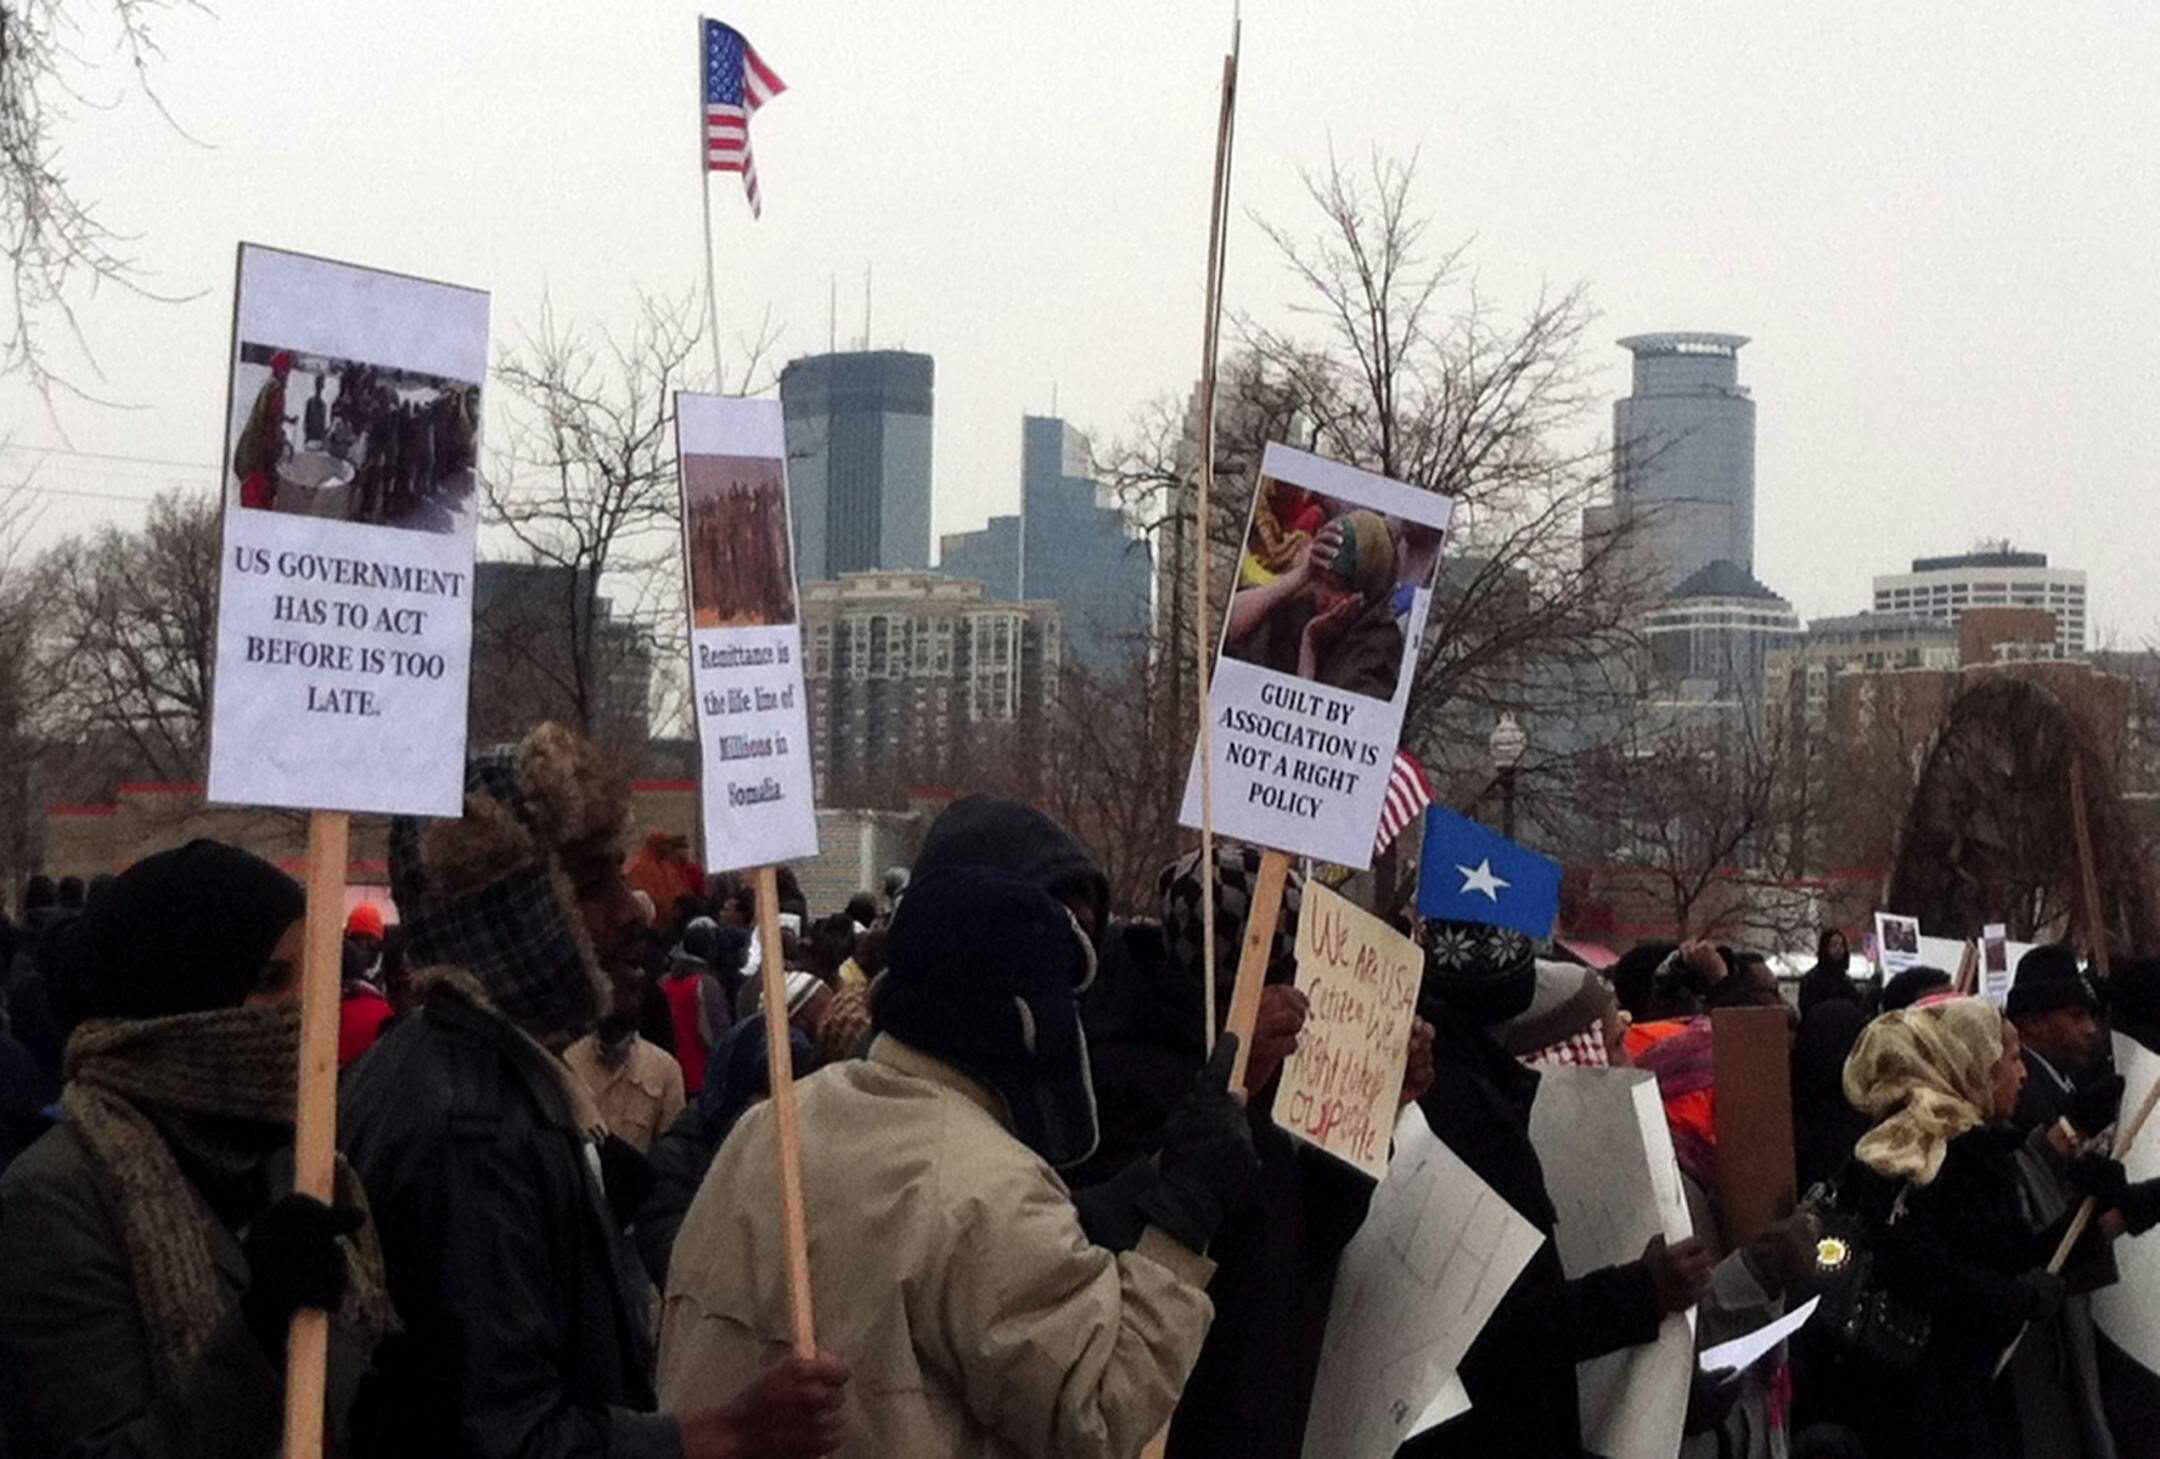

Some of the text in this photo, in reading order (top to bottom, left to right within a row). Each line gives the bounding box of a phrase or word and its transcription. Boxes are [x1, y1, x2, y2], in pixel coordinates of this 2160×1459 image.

[235, 547, 465, 597] US GOVERNMENT
[274, 595, 428, 635] HAS TO ACT
[246, 636, 445, 680] BEFORE IS TOO
[699, 641, 790, 670] Remittance is
[307, 686, 382, 717] LATE.
[703, 683, 795, 716] the life line of
[1261, 683, 1356, 726] GUILT BY
[775, 731, 788, 755] in
[1218, 706, 1380, 766] ASSOCIATION IS
[1226, 742, 1360, 795] NOT A RIGHT
[1248, 782, 1323, 819] POLICY
